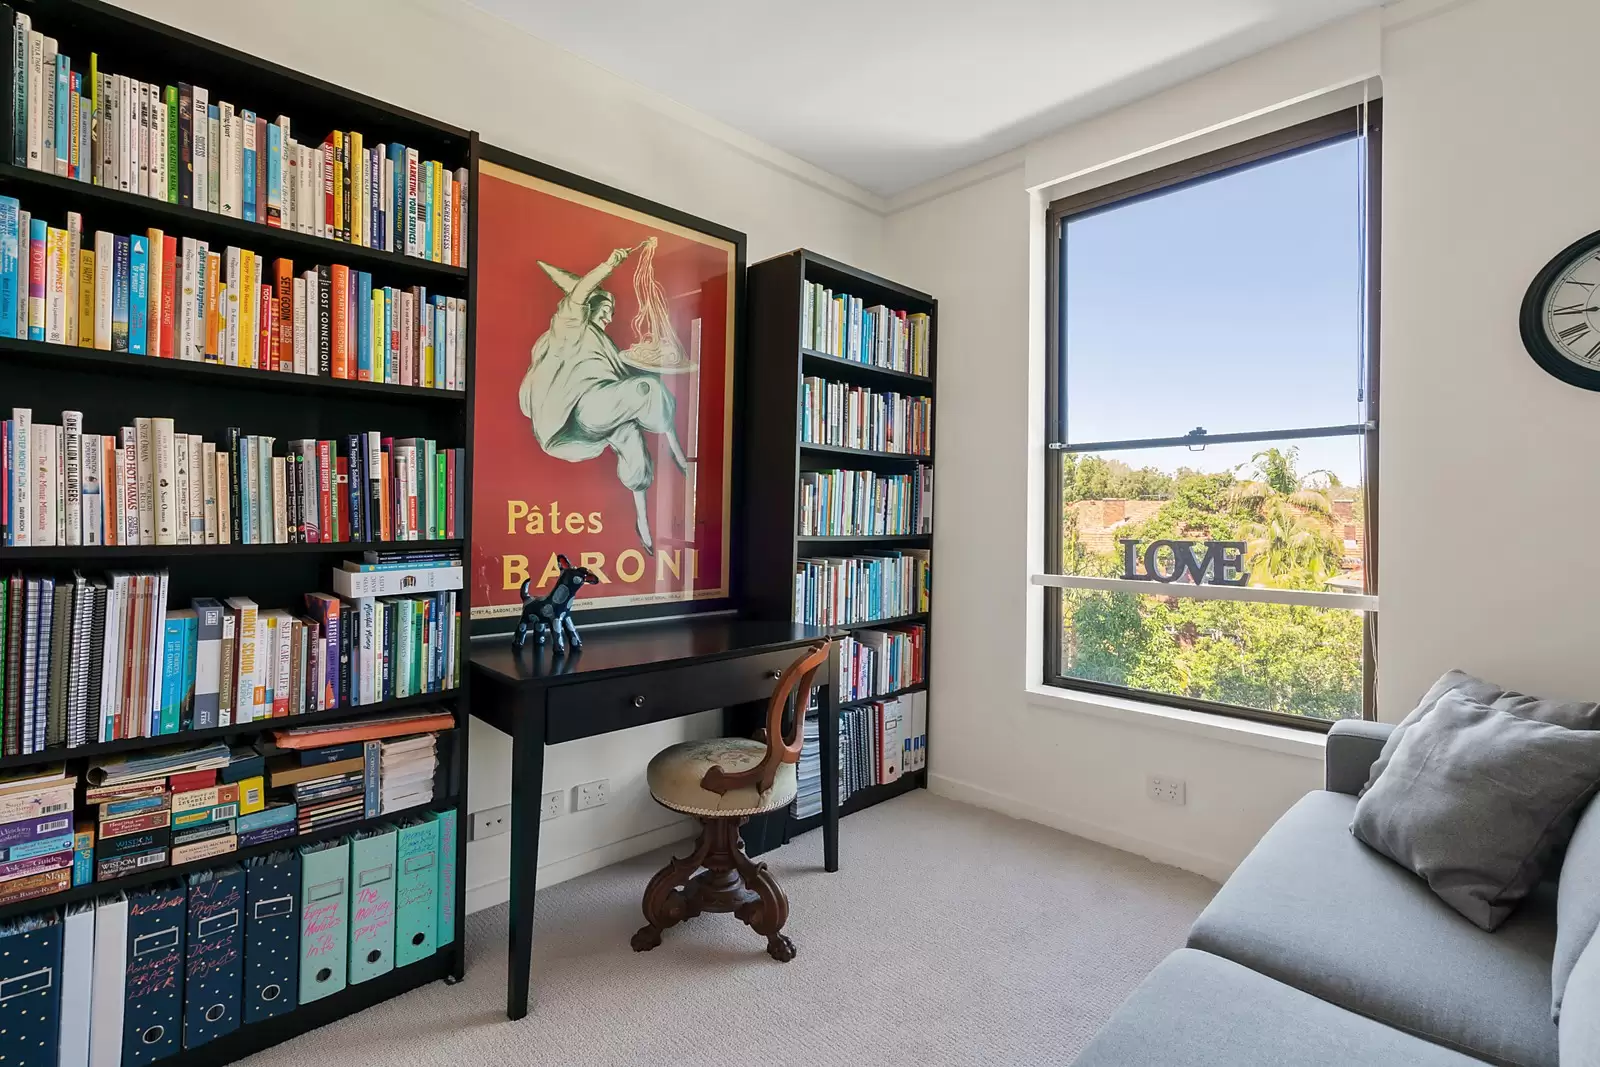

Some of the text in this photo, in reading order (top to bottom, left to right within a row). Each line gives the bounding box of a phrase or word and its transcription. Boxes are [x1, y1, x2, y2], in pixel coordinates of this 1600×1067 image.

[196, 99, 205, 114] ART
[33, 249, 42, 265] JOY
[198, 246, 206, 262] eight
[244, 284, 250, 292] No
[281, 276, 290, 321] SETH GODIN
[18, 429, 26, 449] 11-STEP
[141, 440, 149, 462] ORMAN
[67, 419, 79, 502] ONE MILLION FOLLOWERS
[126, 444, 136, 510] RED HOT MAMAS
[39, 456, 47, 530] The Minute Millionaire
[508, 500, 603, 534] Pâtes
[502, 549, 700, 590] BARONI
[1120, 540, 1251, 586] LOVE
[329, 613, 337, 646] HEARTSICK
[362, 630, 372, 650] Money
[241, 609, 256, 676] MONEY SCHOOL
[222, 675, 230, 703] RECOVERY
[279, 672, 288, 691] LIFE
[46, 872, 67, 880] Map
[101, 858, 136, 870] WISDOM
